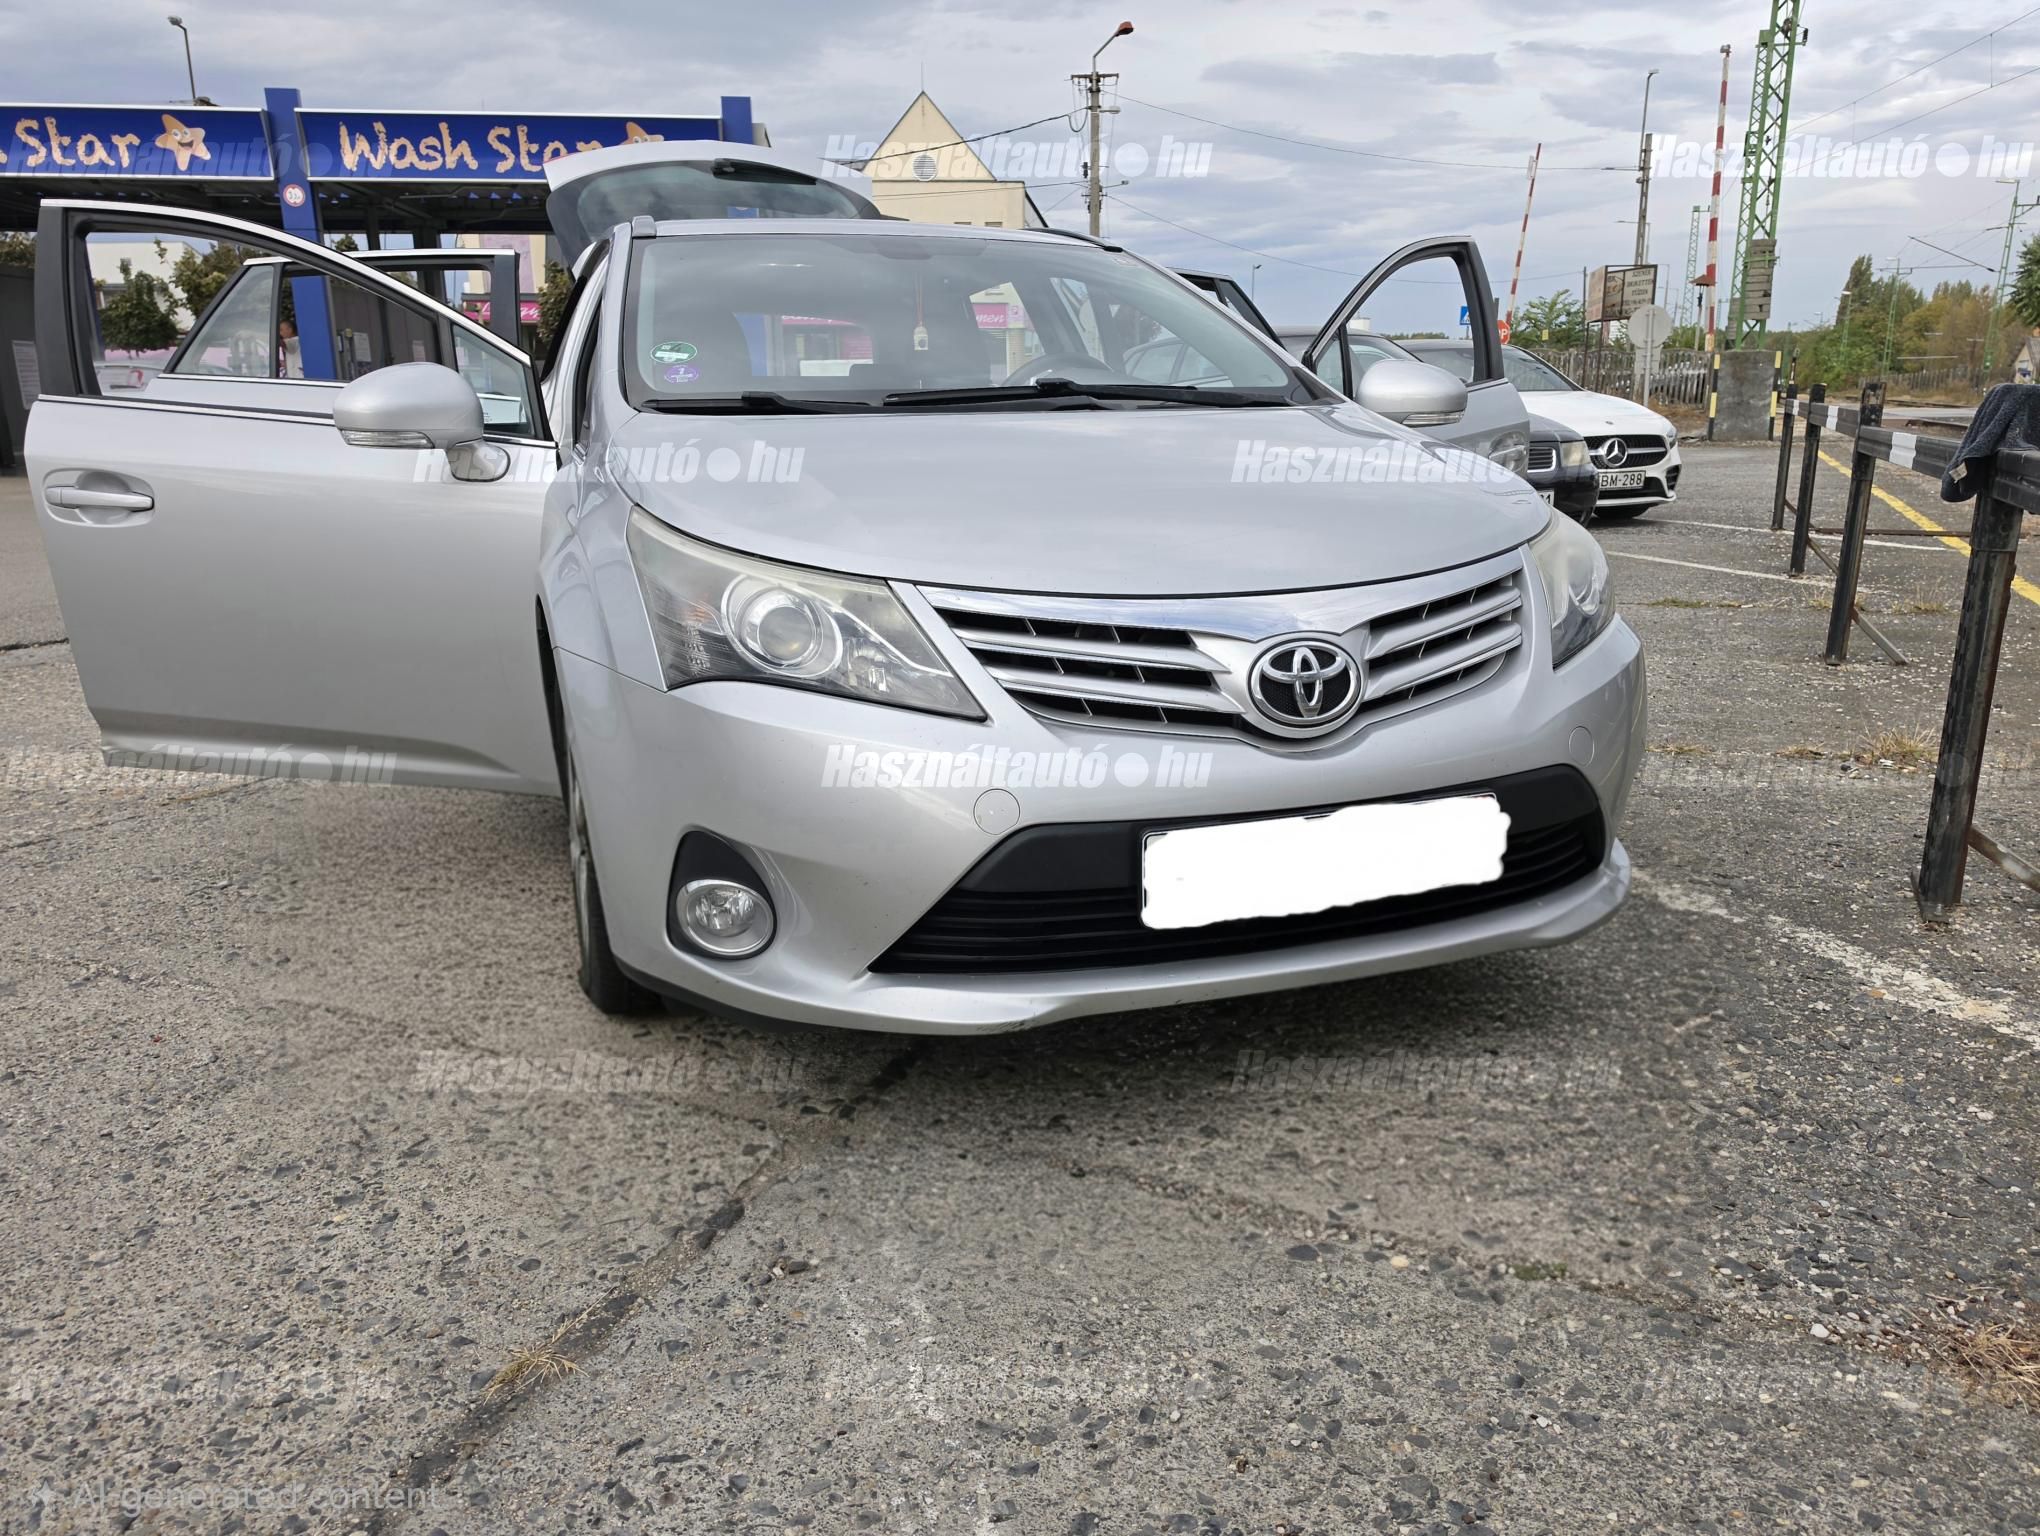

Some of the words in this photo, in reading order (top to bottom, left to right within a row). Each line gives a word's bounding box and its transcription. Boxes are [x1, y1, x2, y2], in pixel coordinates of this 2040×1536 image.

[15, 116, 141, 168] Star
[340, 121, 478, 171] Wash
[1600, 473, 1643, 487] BM-288
